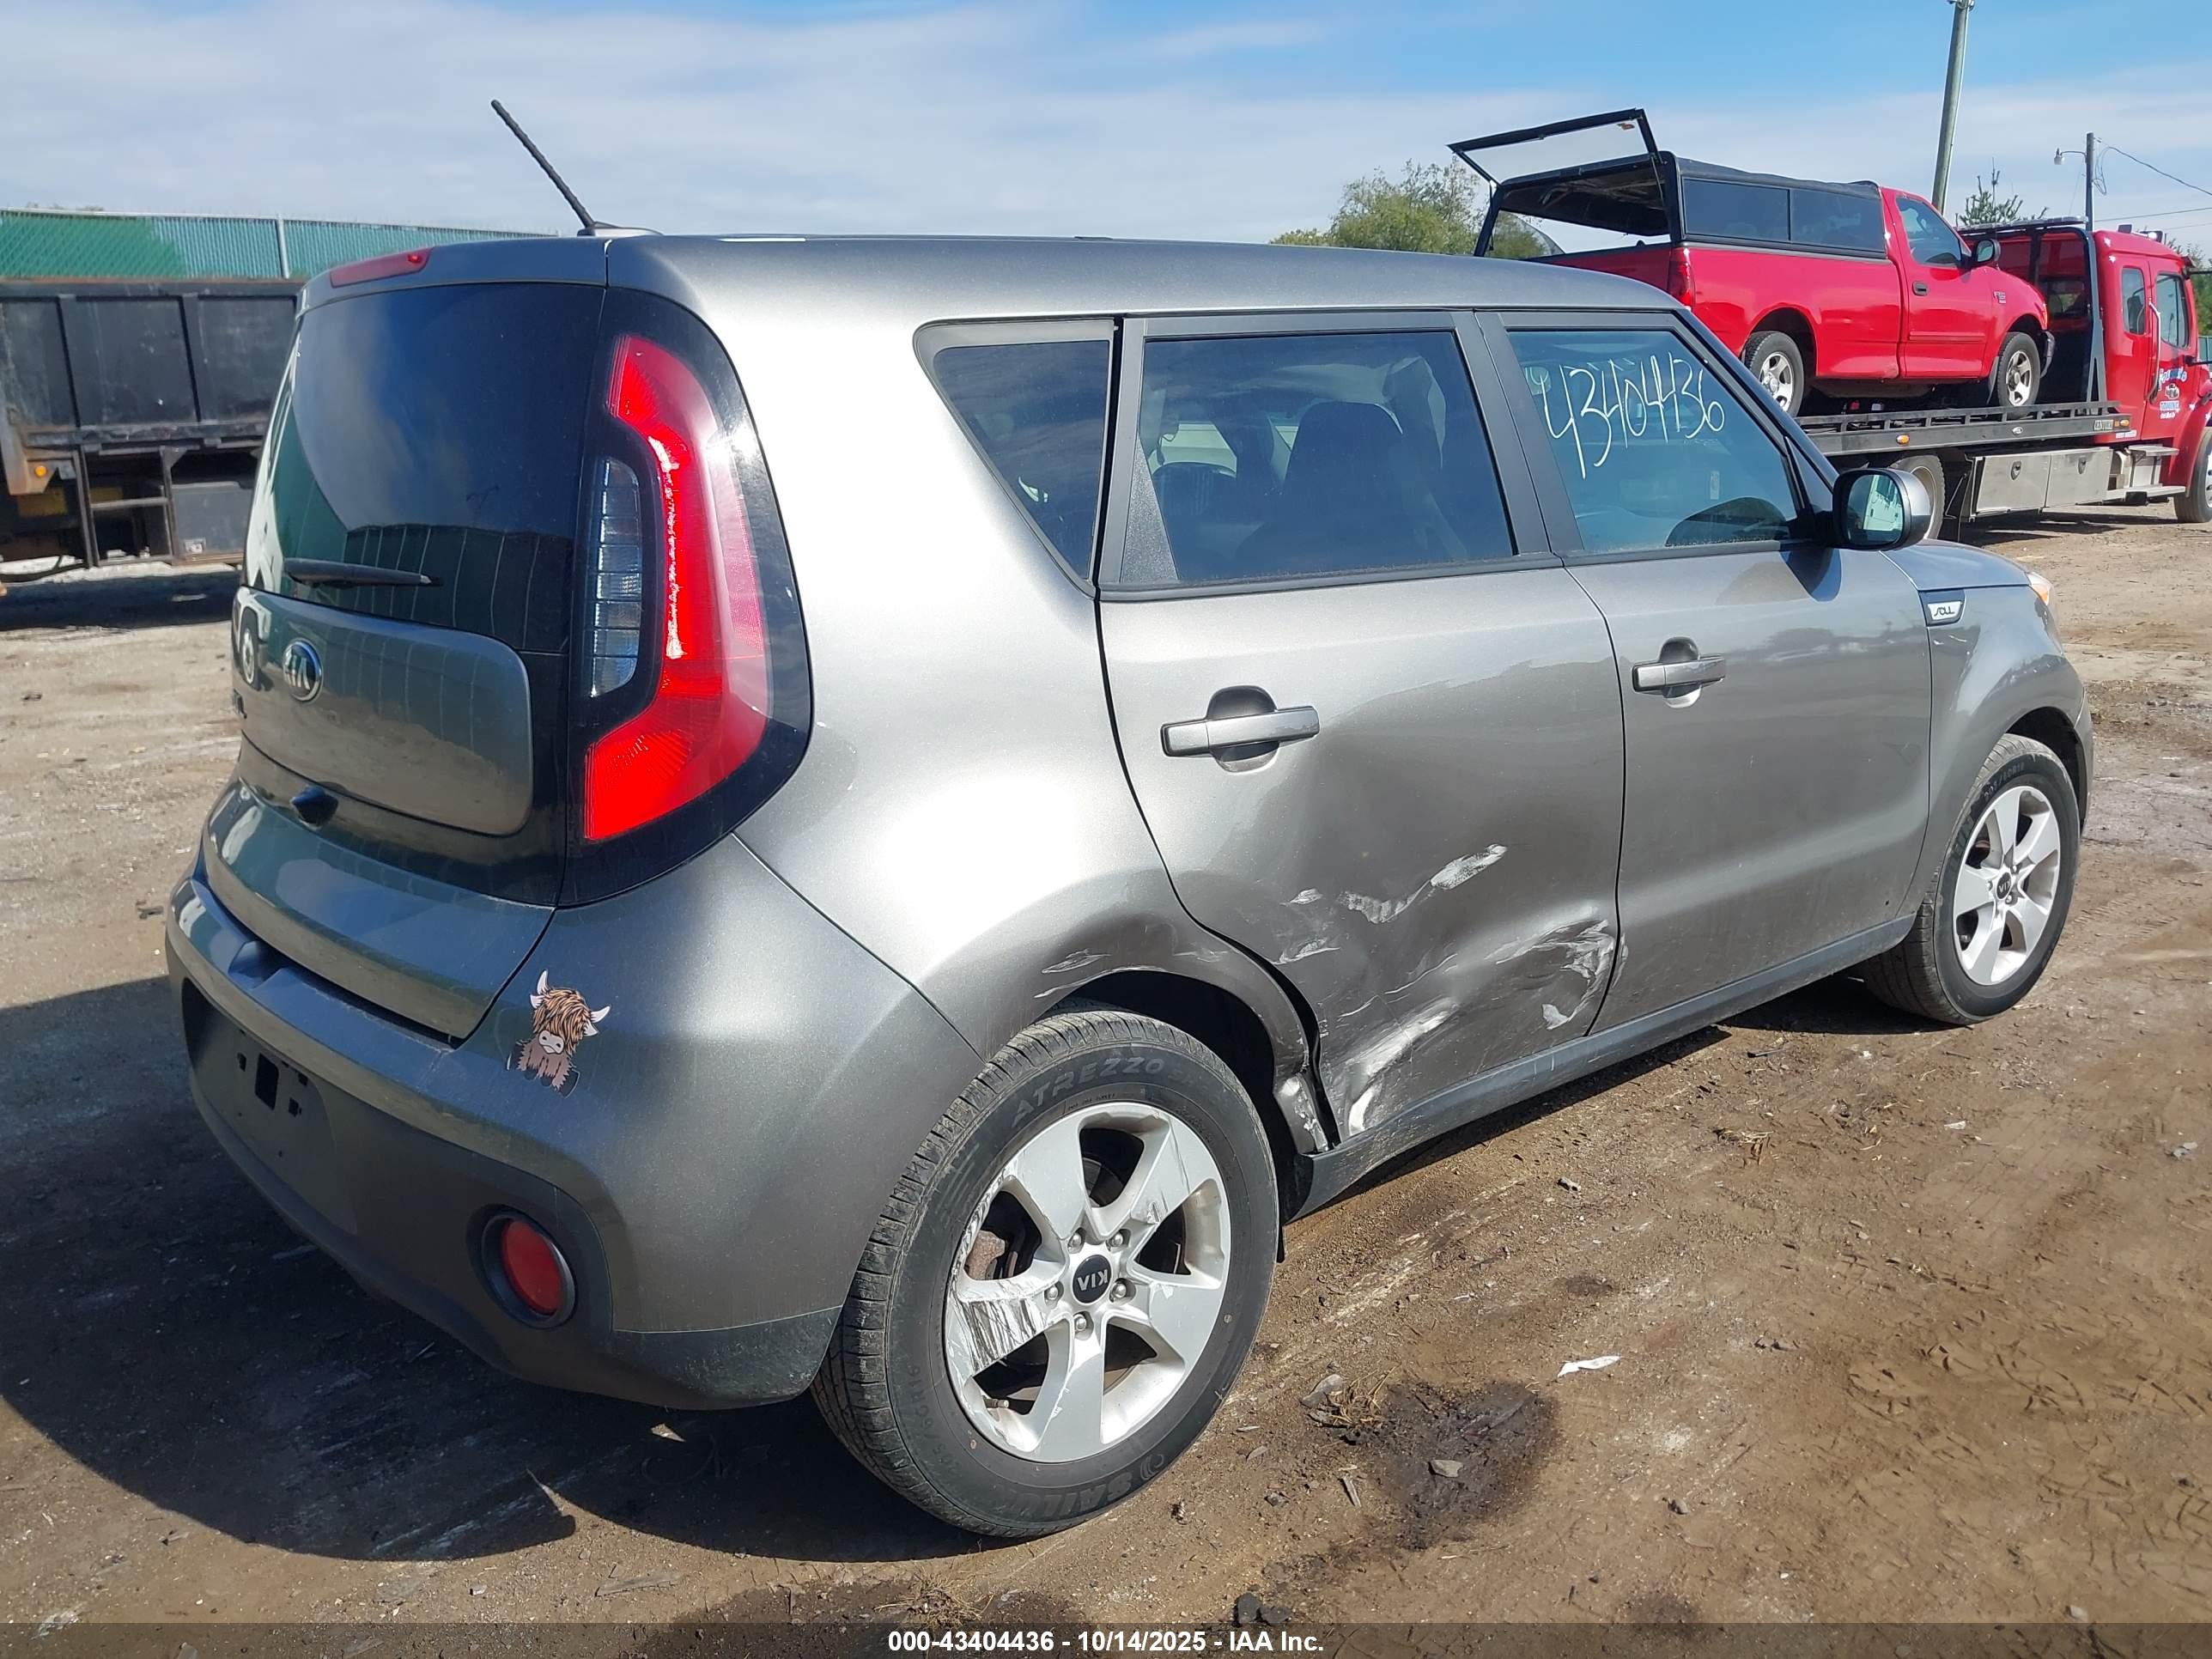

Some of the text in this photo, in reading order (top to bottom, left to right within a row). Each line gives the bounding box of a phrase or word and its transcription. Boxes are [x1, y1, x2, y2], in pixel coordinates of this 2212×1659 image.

[1540, 351, 1725, 479] 43404436
[283, 643, 311, 690] KIA
[1011, 1056, 1165, 1128] ATREZZO
